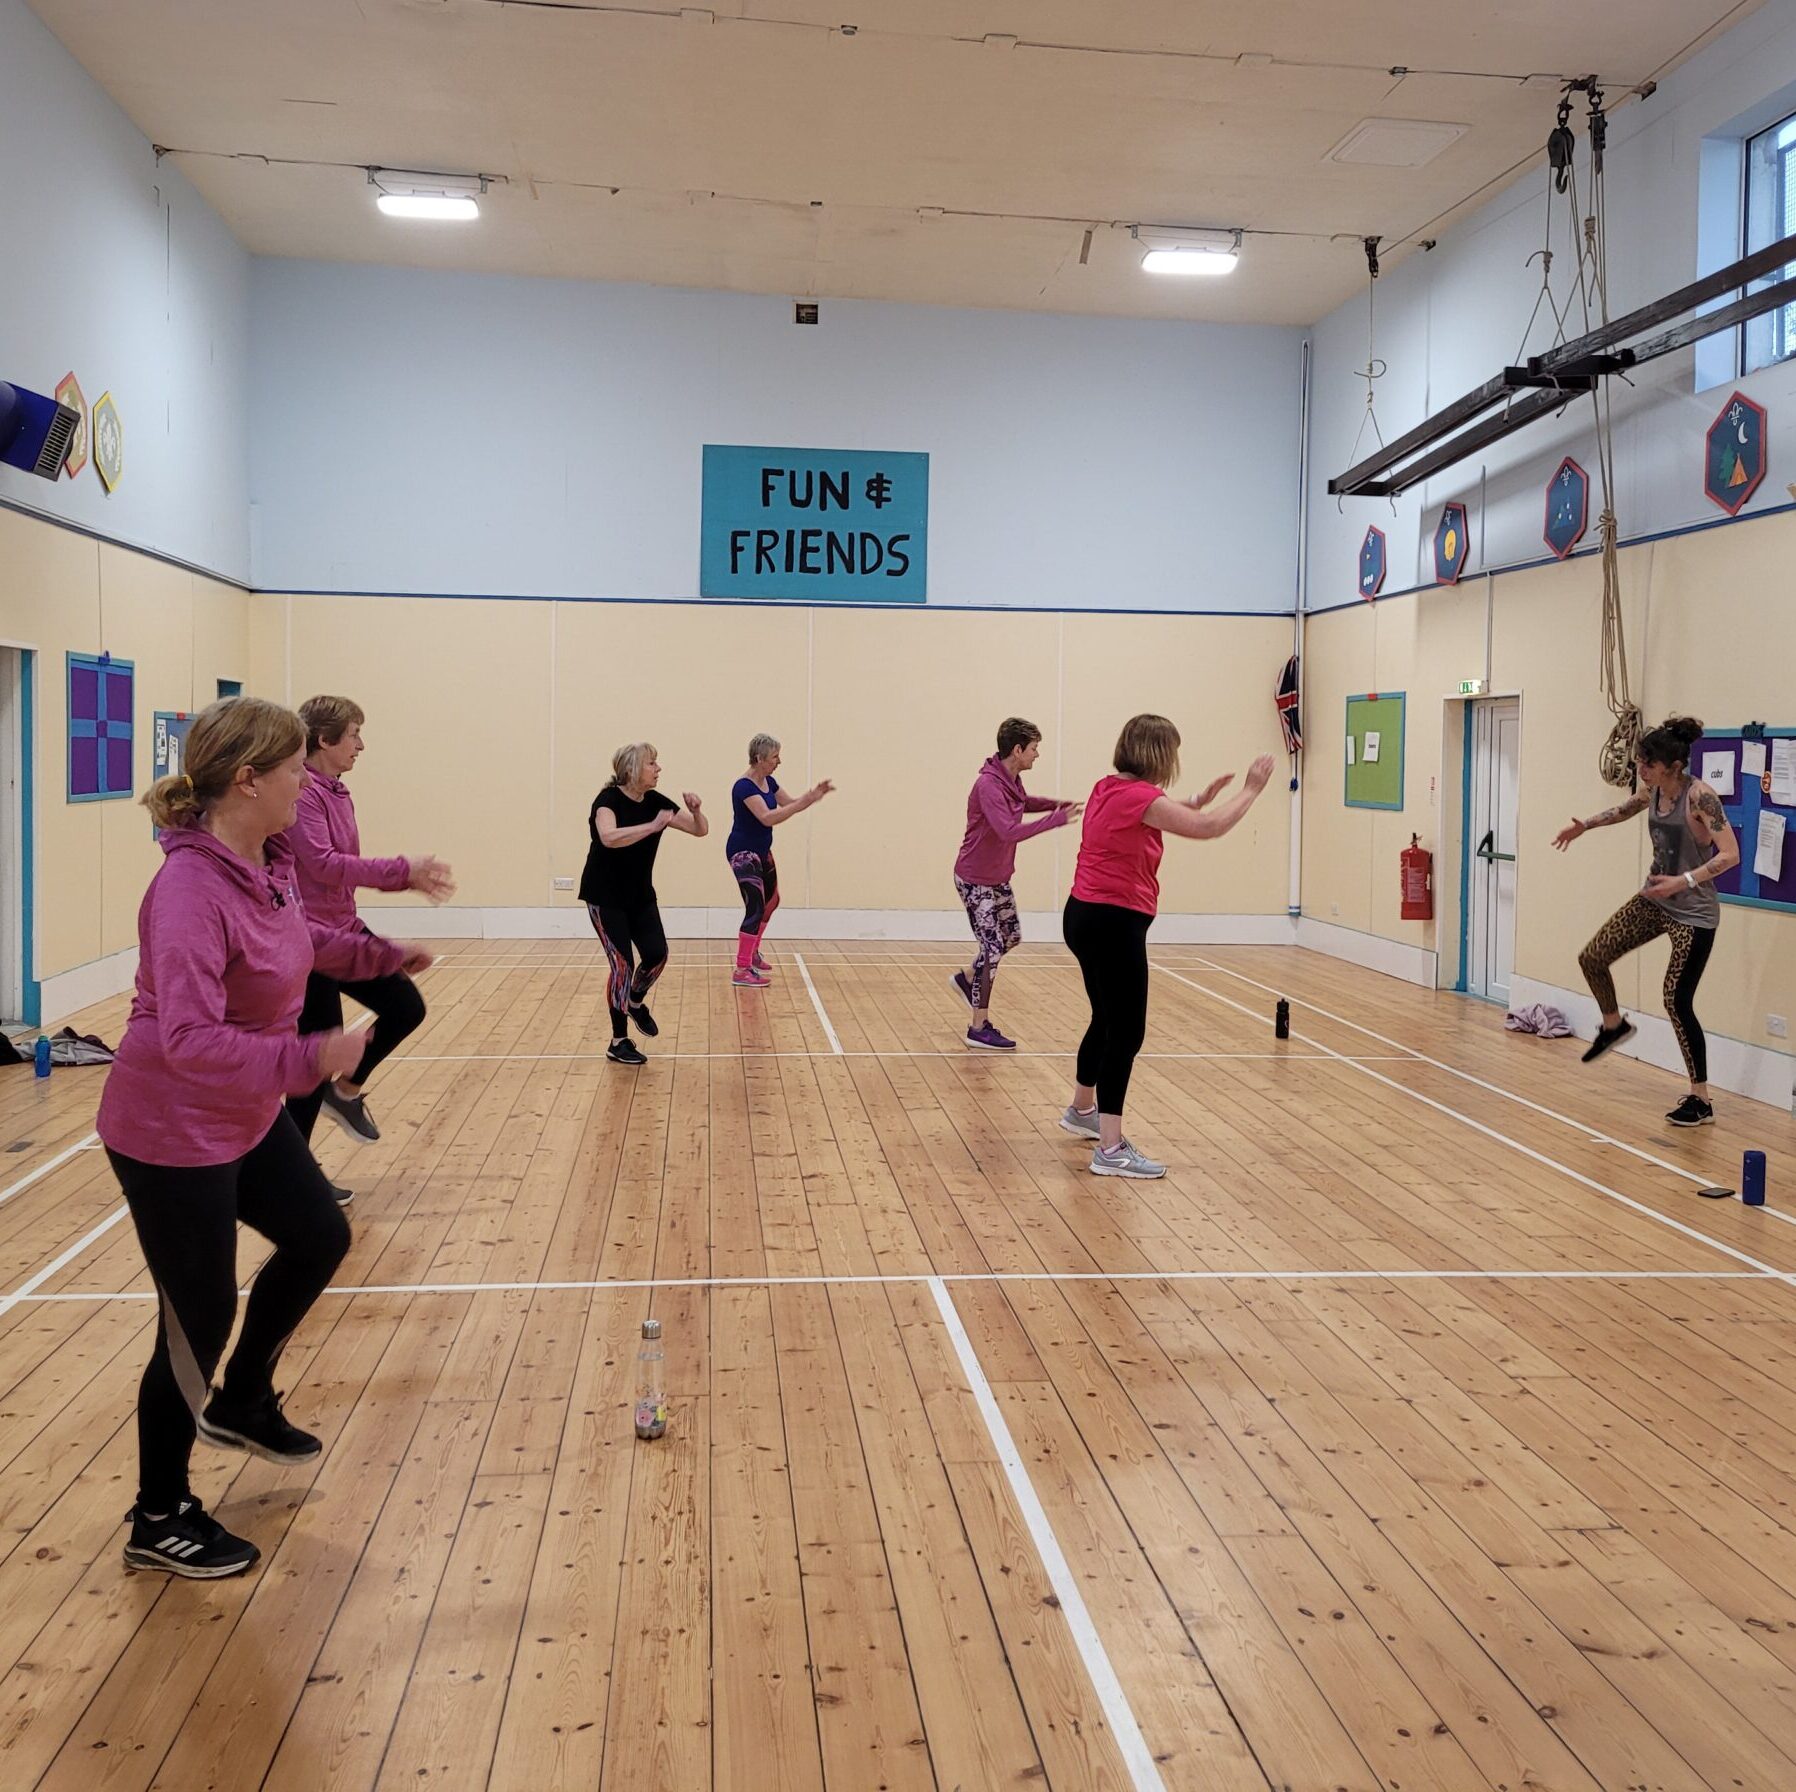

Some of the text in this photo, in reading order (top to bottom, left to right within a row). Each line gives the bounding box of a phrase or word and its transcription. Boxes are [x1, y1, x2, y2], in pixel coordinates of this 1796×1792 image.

[761, 468, 893, 511] FUN &
[730, 529, 910, 577] FRIENDS
